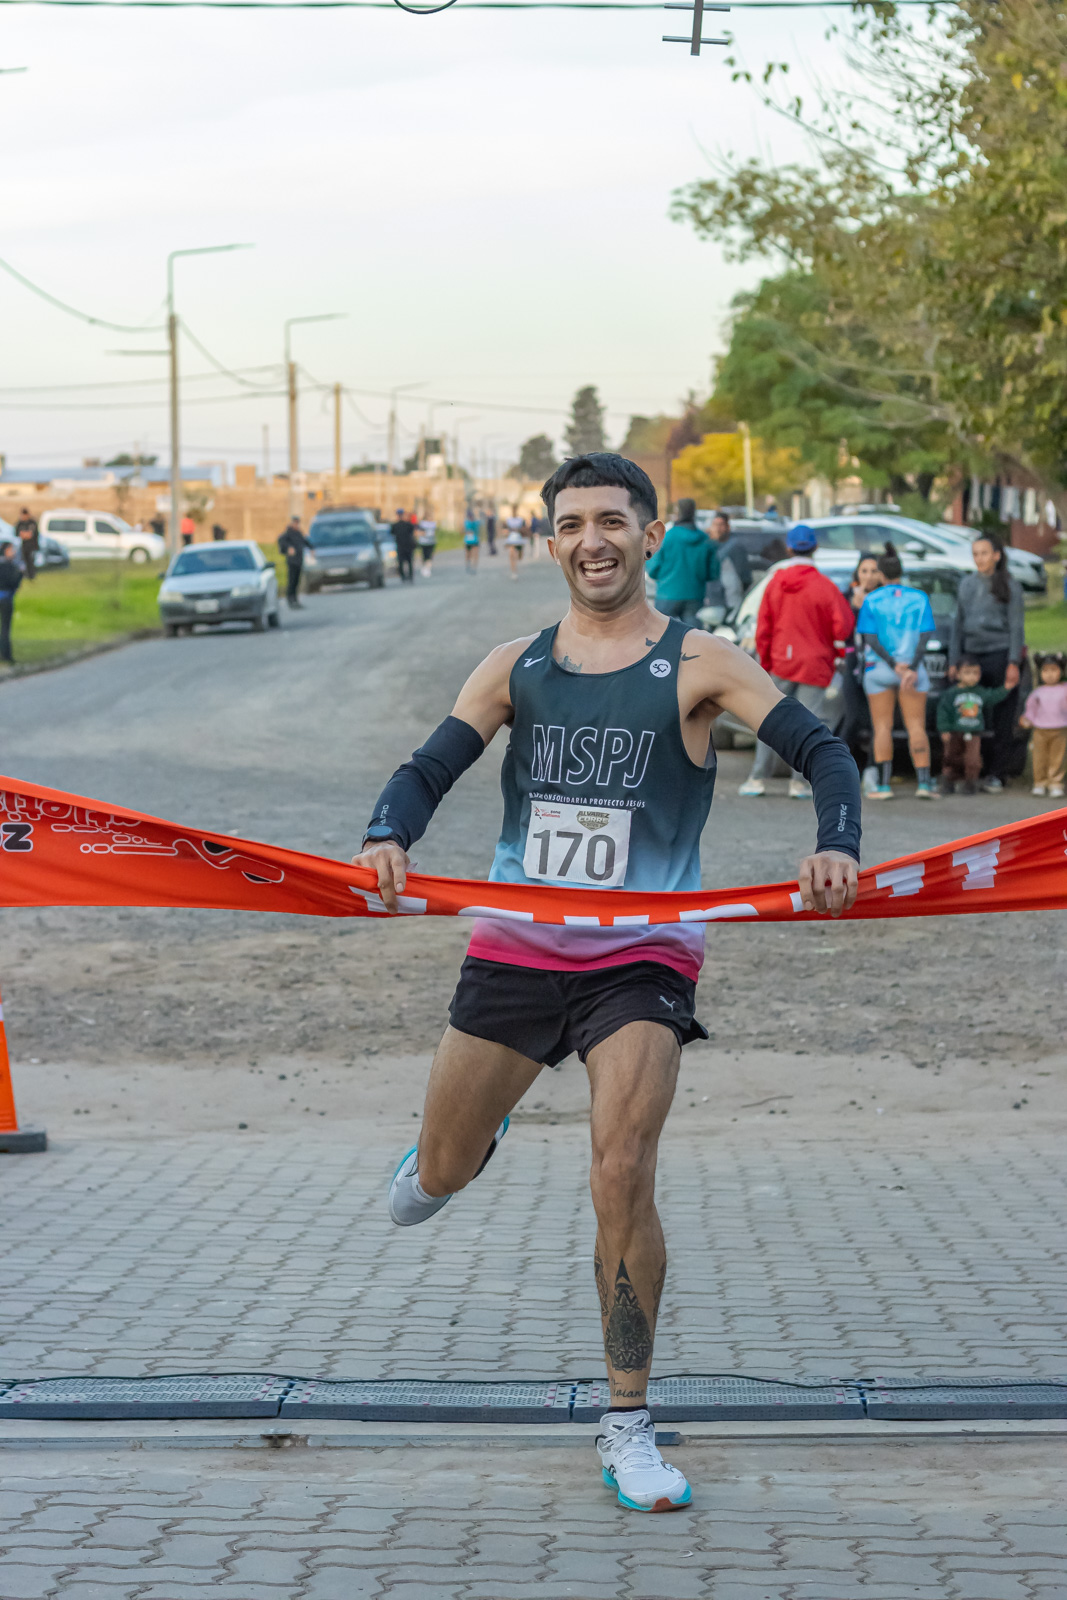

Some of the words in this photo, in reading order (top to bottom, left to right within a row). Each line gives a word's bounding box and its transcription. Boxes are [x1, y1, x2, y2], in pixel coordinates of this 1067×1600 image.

[531, 724, 656, 788] MSPJ
[552, 794, 588, 804] SOLIDARIA
[589, 798, 624, 807] PROYECTO
[625, 799, 646, 808] JESÚS
[577, 810, 610, 819] ALVAREZ
[578, 816, 609, 824] CORRE
[533, 829, 616, 881] 170
